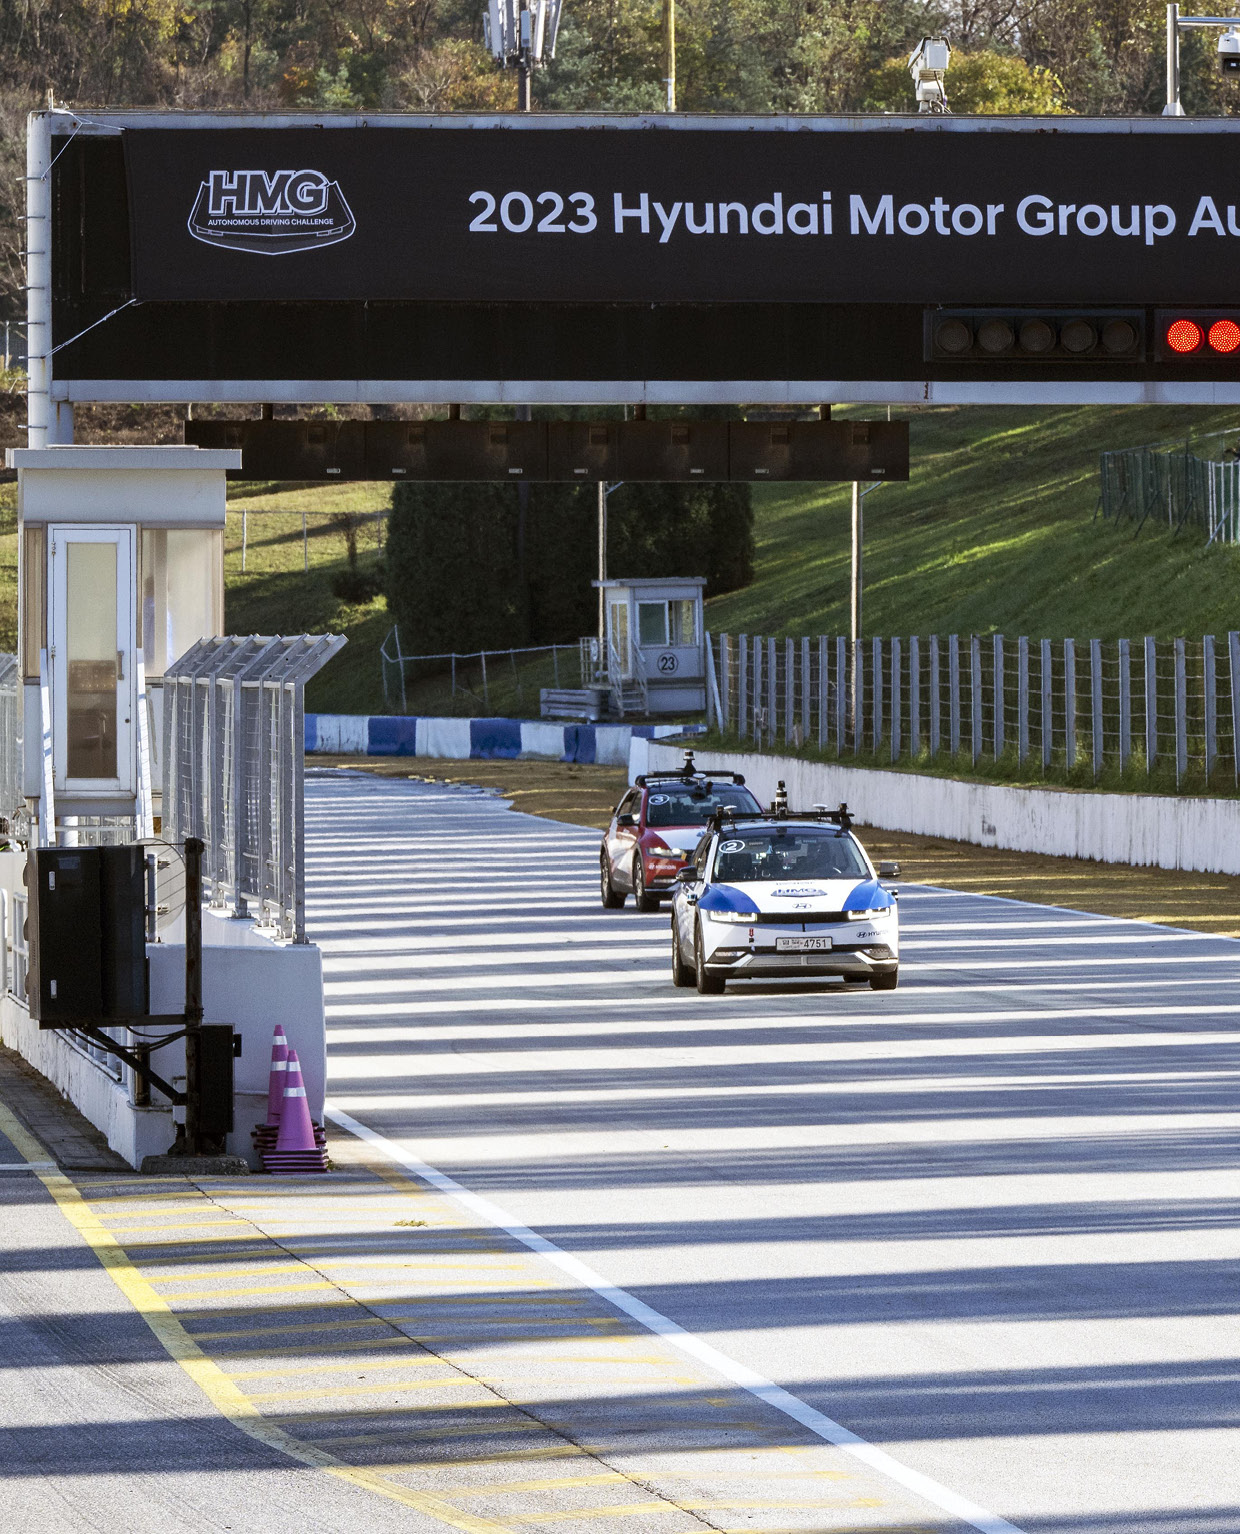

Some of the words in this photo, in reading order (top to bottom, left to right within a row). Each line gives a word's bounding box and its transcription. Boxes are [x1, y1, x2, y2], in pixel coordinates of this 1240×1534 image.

[208, 169, 329, 216] HMG
[207, 218, 260, 226] AUTONOMOUS
[260, 218, 290, 226] DRIVING
[290, 218, 334, 226] CHALLENGE
[468, 190, 598, 234] 2023
[613, 190, 833, 244] Hyundai
[849, 194, 1005, 236] Motor
[1016, 194, 1177, 246] Group
[660, 656, 676, 671] 23
[803, 938, 827, 949] 4751
